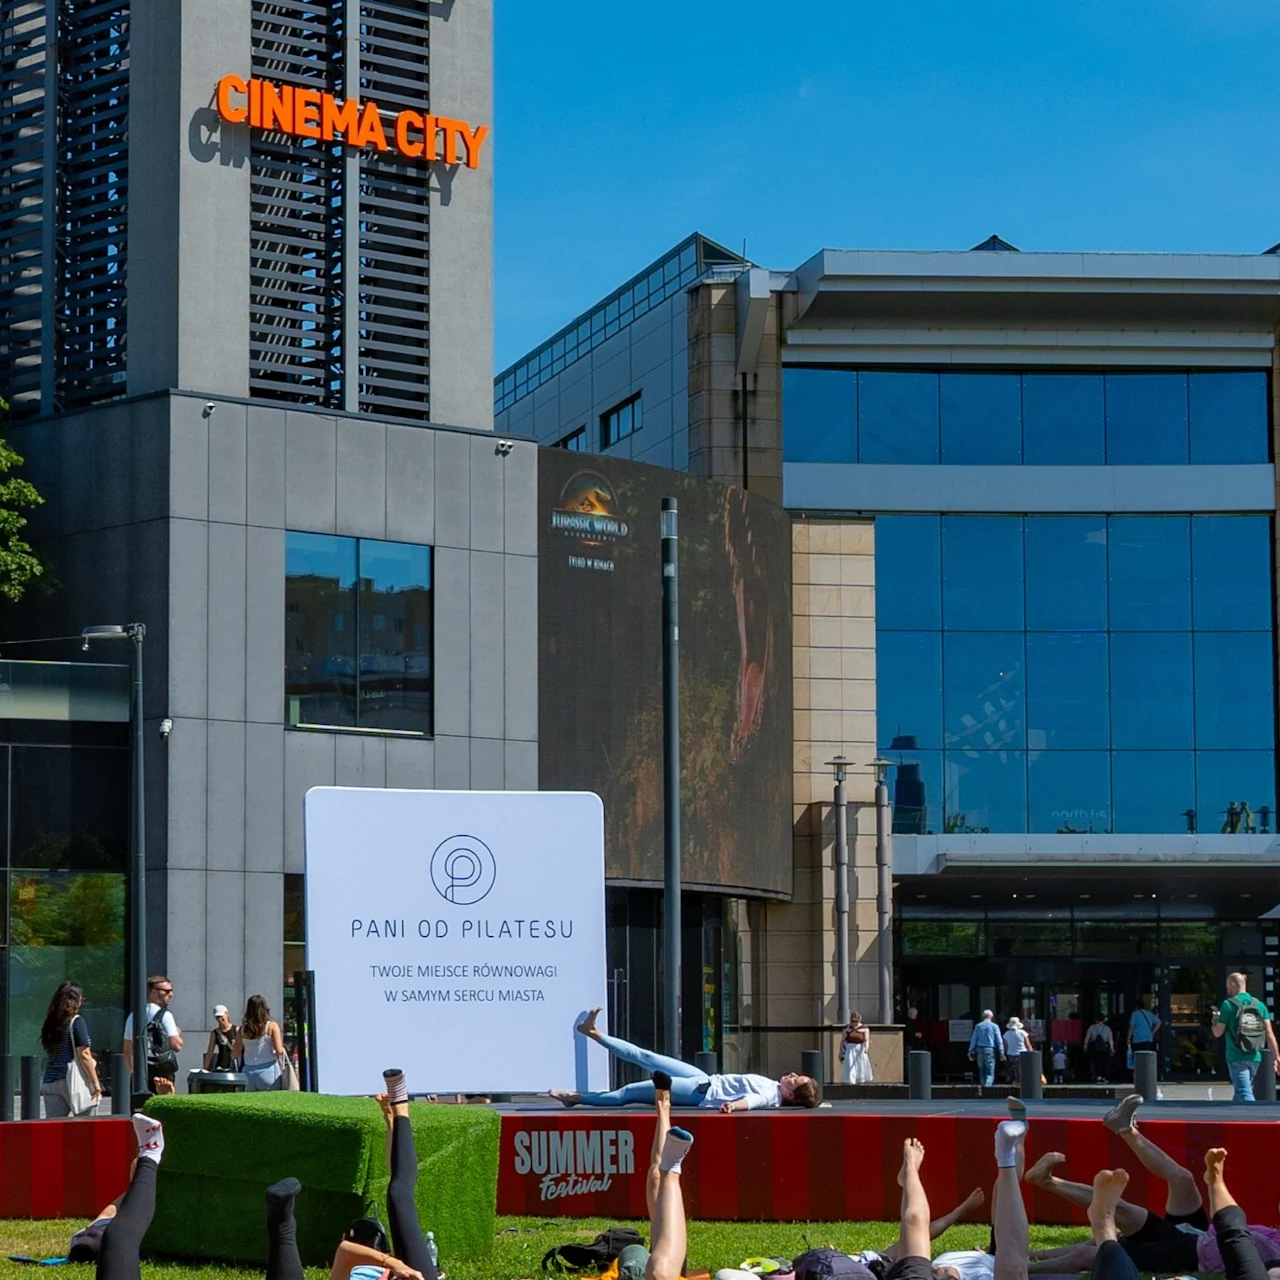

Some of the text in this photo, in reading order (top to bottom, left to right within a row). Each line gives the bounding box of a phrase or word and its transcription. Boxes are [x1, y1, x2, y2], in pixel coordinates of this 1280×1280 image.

[216, 74, 488, 170] CINEMA CITY
[551, 511, 591, 531] JURASSIC
[593, 517, 628, 537] WORLD
[351, 919, 574, 938] PANI OD PILATESU
[370, 962, 558, 978] TWOJE MIEJSCE RÓWNOWAGI
[384, 990, 545, 1002] W SAMYM SERCU MIASTA
[514, 1130, 635, 1175] SUMMER
[539, 1173, 612, 1201] Festival
